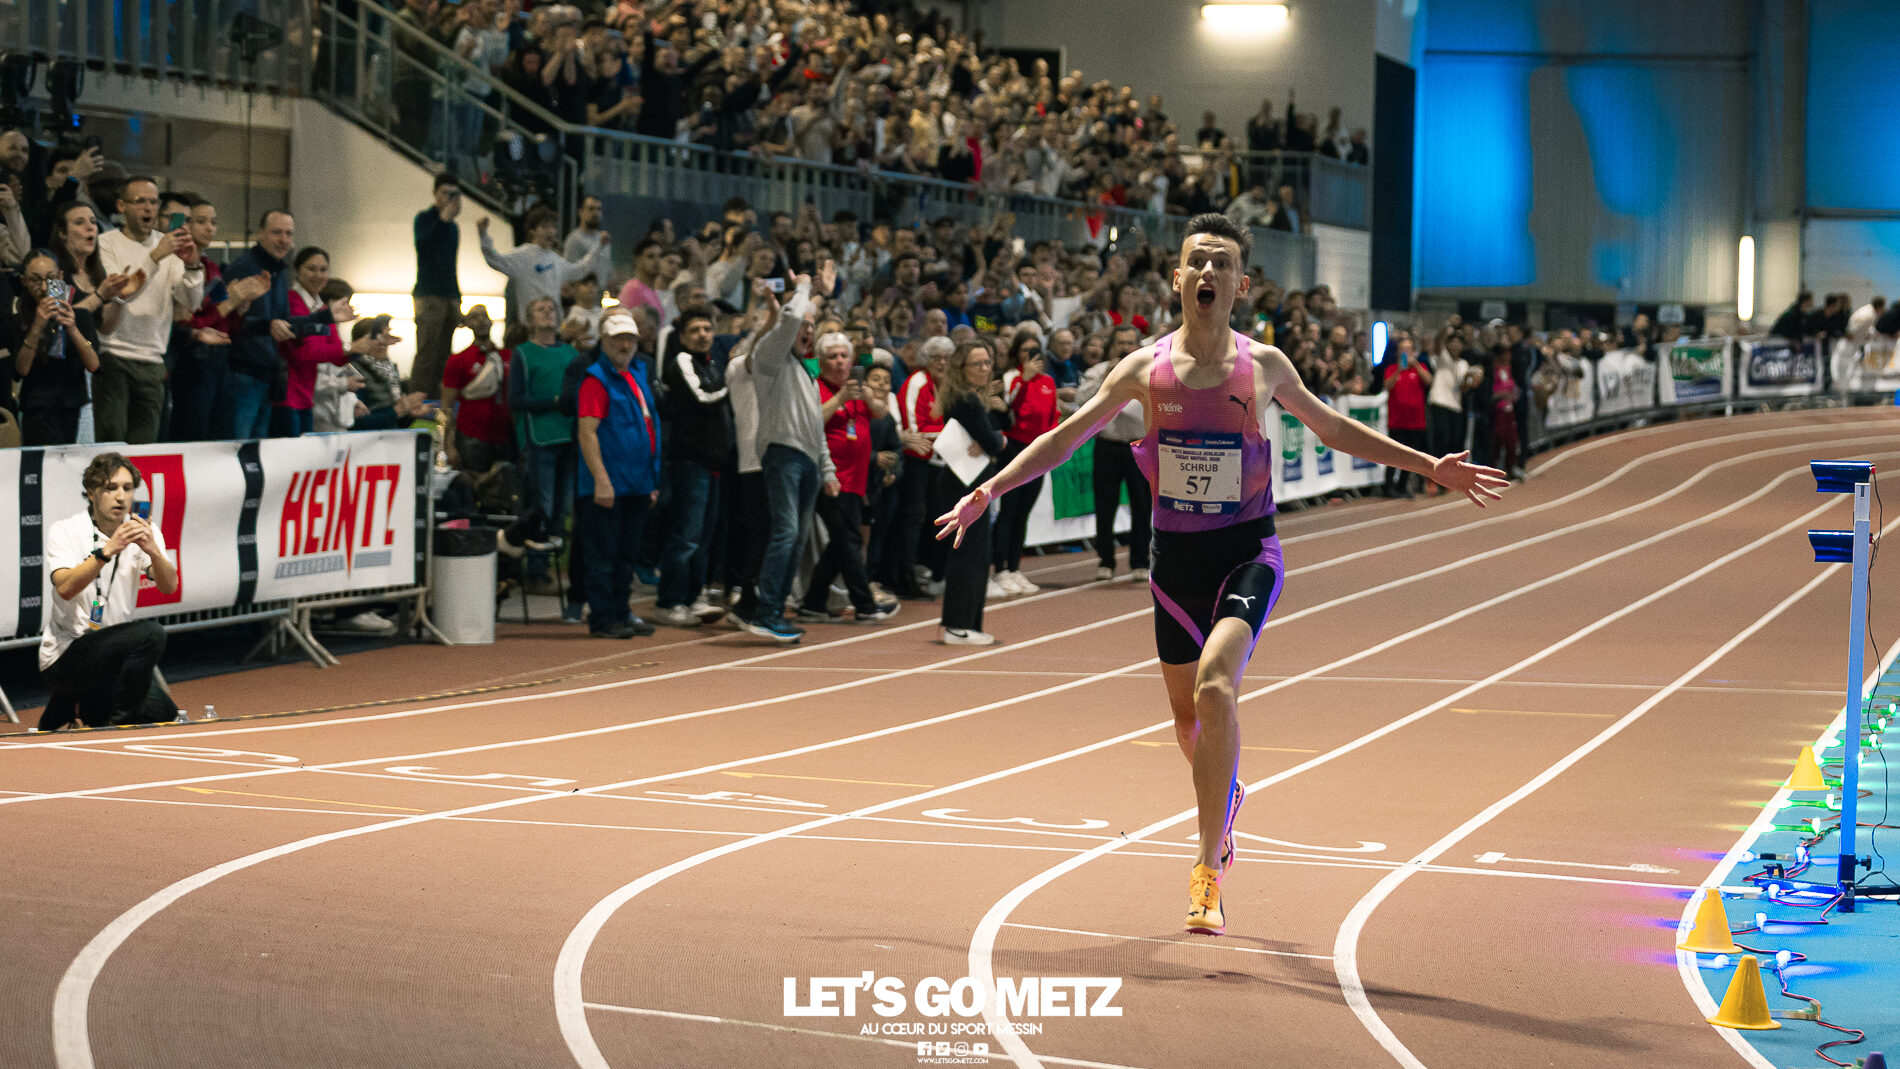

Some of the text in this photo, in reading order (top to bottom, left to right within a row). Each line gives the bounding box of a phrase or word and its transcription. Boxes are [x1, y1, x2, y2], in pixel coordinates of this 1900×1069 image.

[1180, 463, 1218, 472] SCHRUB
[1186, 475, 1212, 495] 57
[279, 445, 400, 578] HEINTZ
